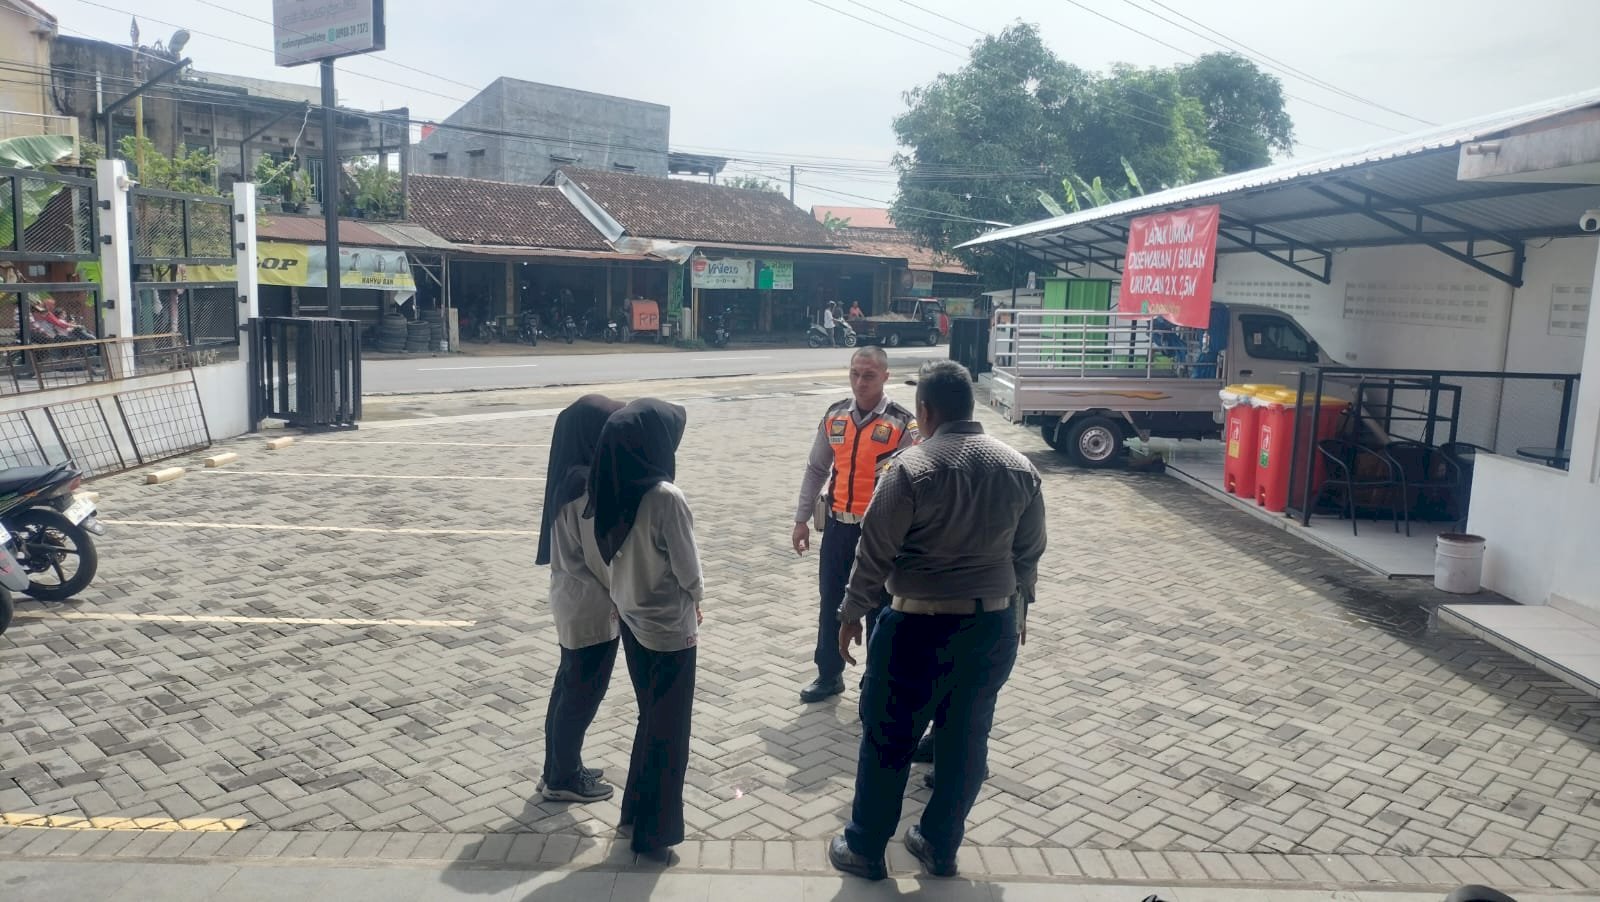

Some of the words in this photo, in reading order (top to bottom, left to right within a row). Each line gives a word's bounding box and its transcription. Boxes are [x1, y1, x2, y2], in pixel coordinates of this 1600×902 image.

[1144, 226, 1168, 247] LAPAK
[1169, 223, 1195, 244] UMKM
[1127, 250, 1172, 270] DISEWAKAN
[1178, 247, 1208, 269] BULAN
[1129, 275, 1165, 295] UKURAN
